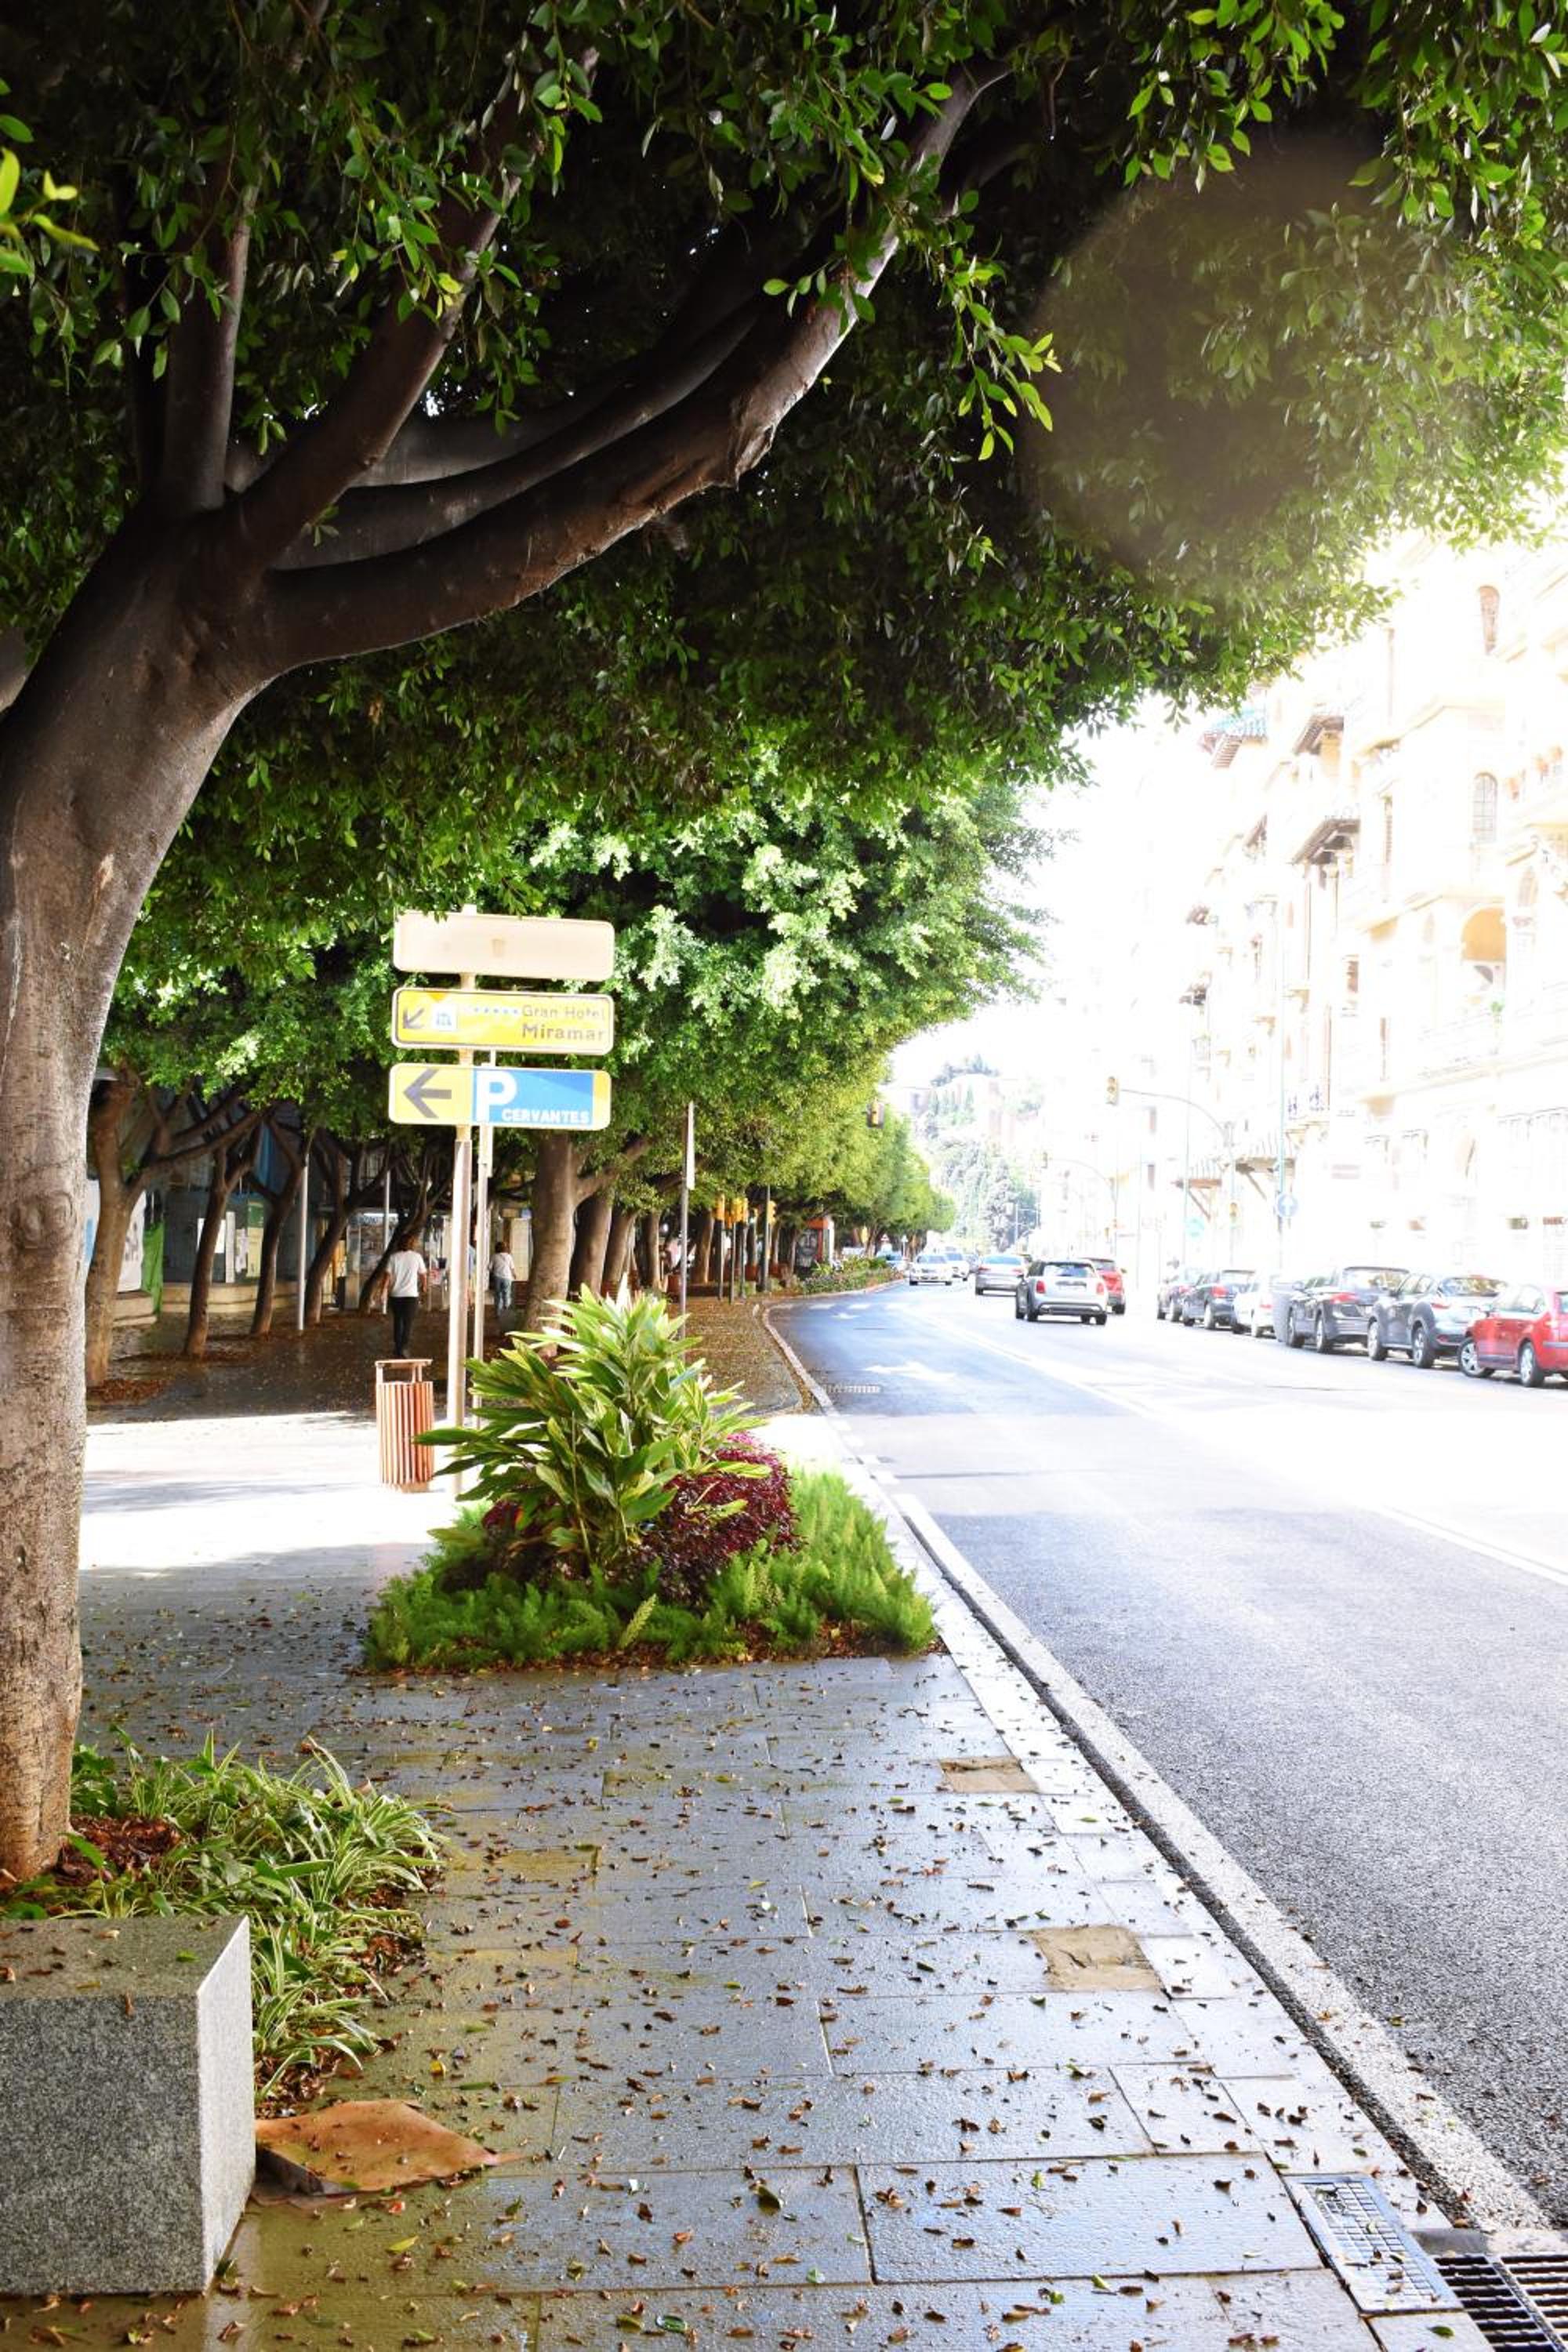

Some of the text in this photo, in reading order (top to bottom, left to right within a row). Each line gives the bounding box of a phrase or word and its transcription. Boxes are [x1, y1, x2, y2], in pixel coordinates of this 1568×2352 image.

[523, 1005, 604, 1020] Gran Hotel
[522, 1023, 604, 1040] Miramar
[476, 1071, 517, 1123] P
[503, 1109, 589, 1123] CERVANTES
